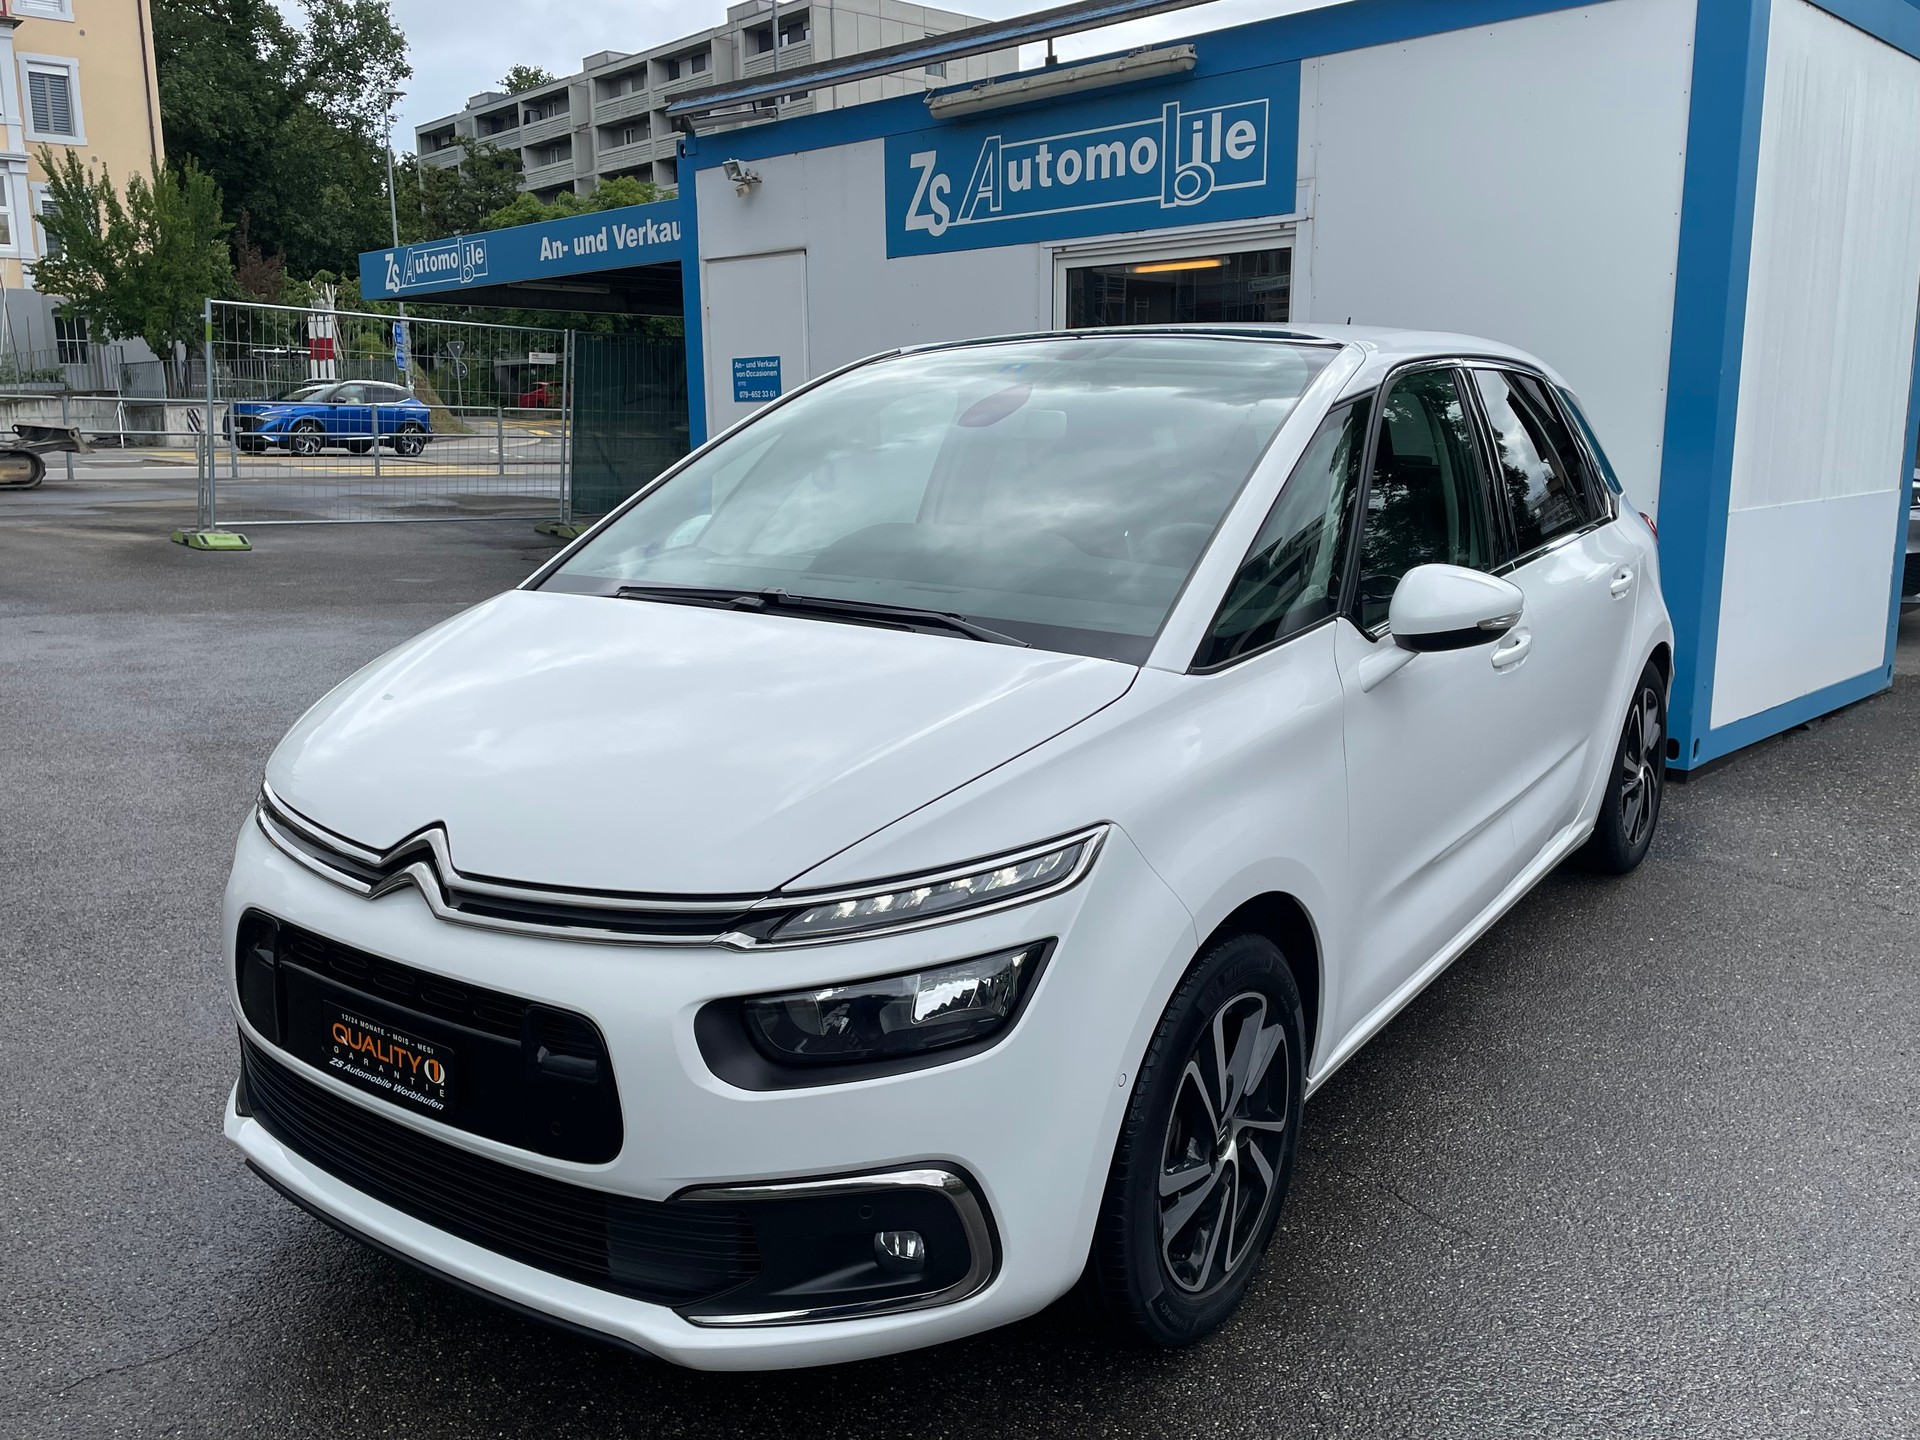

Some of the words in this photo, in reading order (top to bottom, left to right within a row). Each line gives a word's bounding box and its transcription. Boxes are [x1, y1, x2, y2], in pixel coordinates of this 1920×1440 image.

[957, 100, 1257, 222] Automobile
[401, 237, 485, 288] Automobile
[540, 236, 569, 261] An-
[573, 226, 608, 256] und
[757, 360, 778, 368] Verkauf
[359, 1020, 385, 1036] MONATE
[392, 1033, 409, 1046] MOIS
[417, 1041, 434, 1055] MESI
[329, 1057, 345, 1068] ZS
[342, 1063, 393, 1089] Automobile
[392, 1083, 445, 1111] Worblaufen
